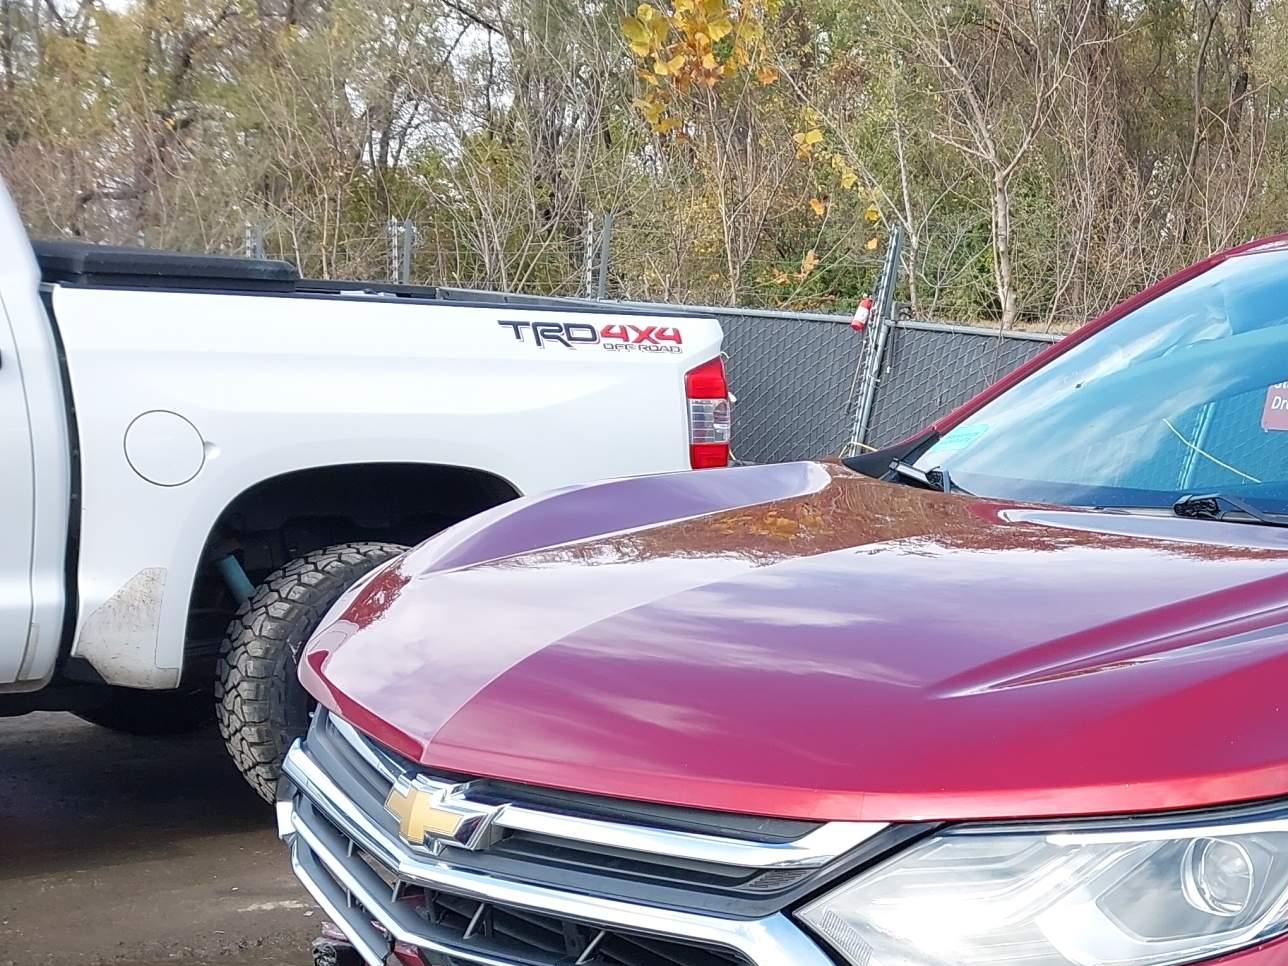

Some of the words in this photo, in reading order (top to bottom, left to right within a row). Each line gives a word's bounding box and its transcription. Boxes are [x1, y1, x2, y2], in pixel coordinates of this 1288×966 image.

[497, 320, 600, 350] TRD
[603, 343, 634, 352] OFF
[638, 344, 682, 353] ROAD
